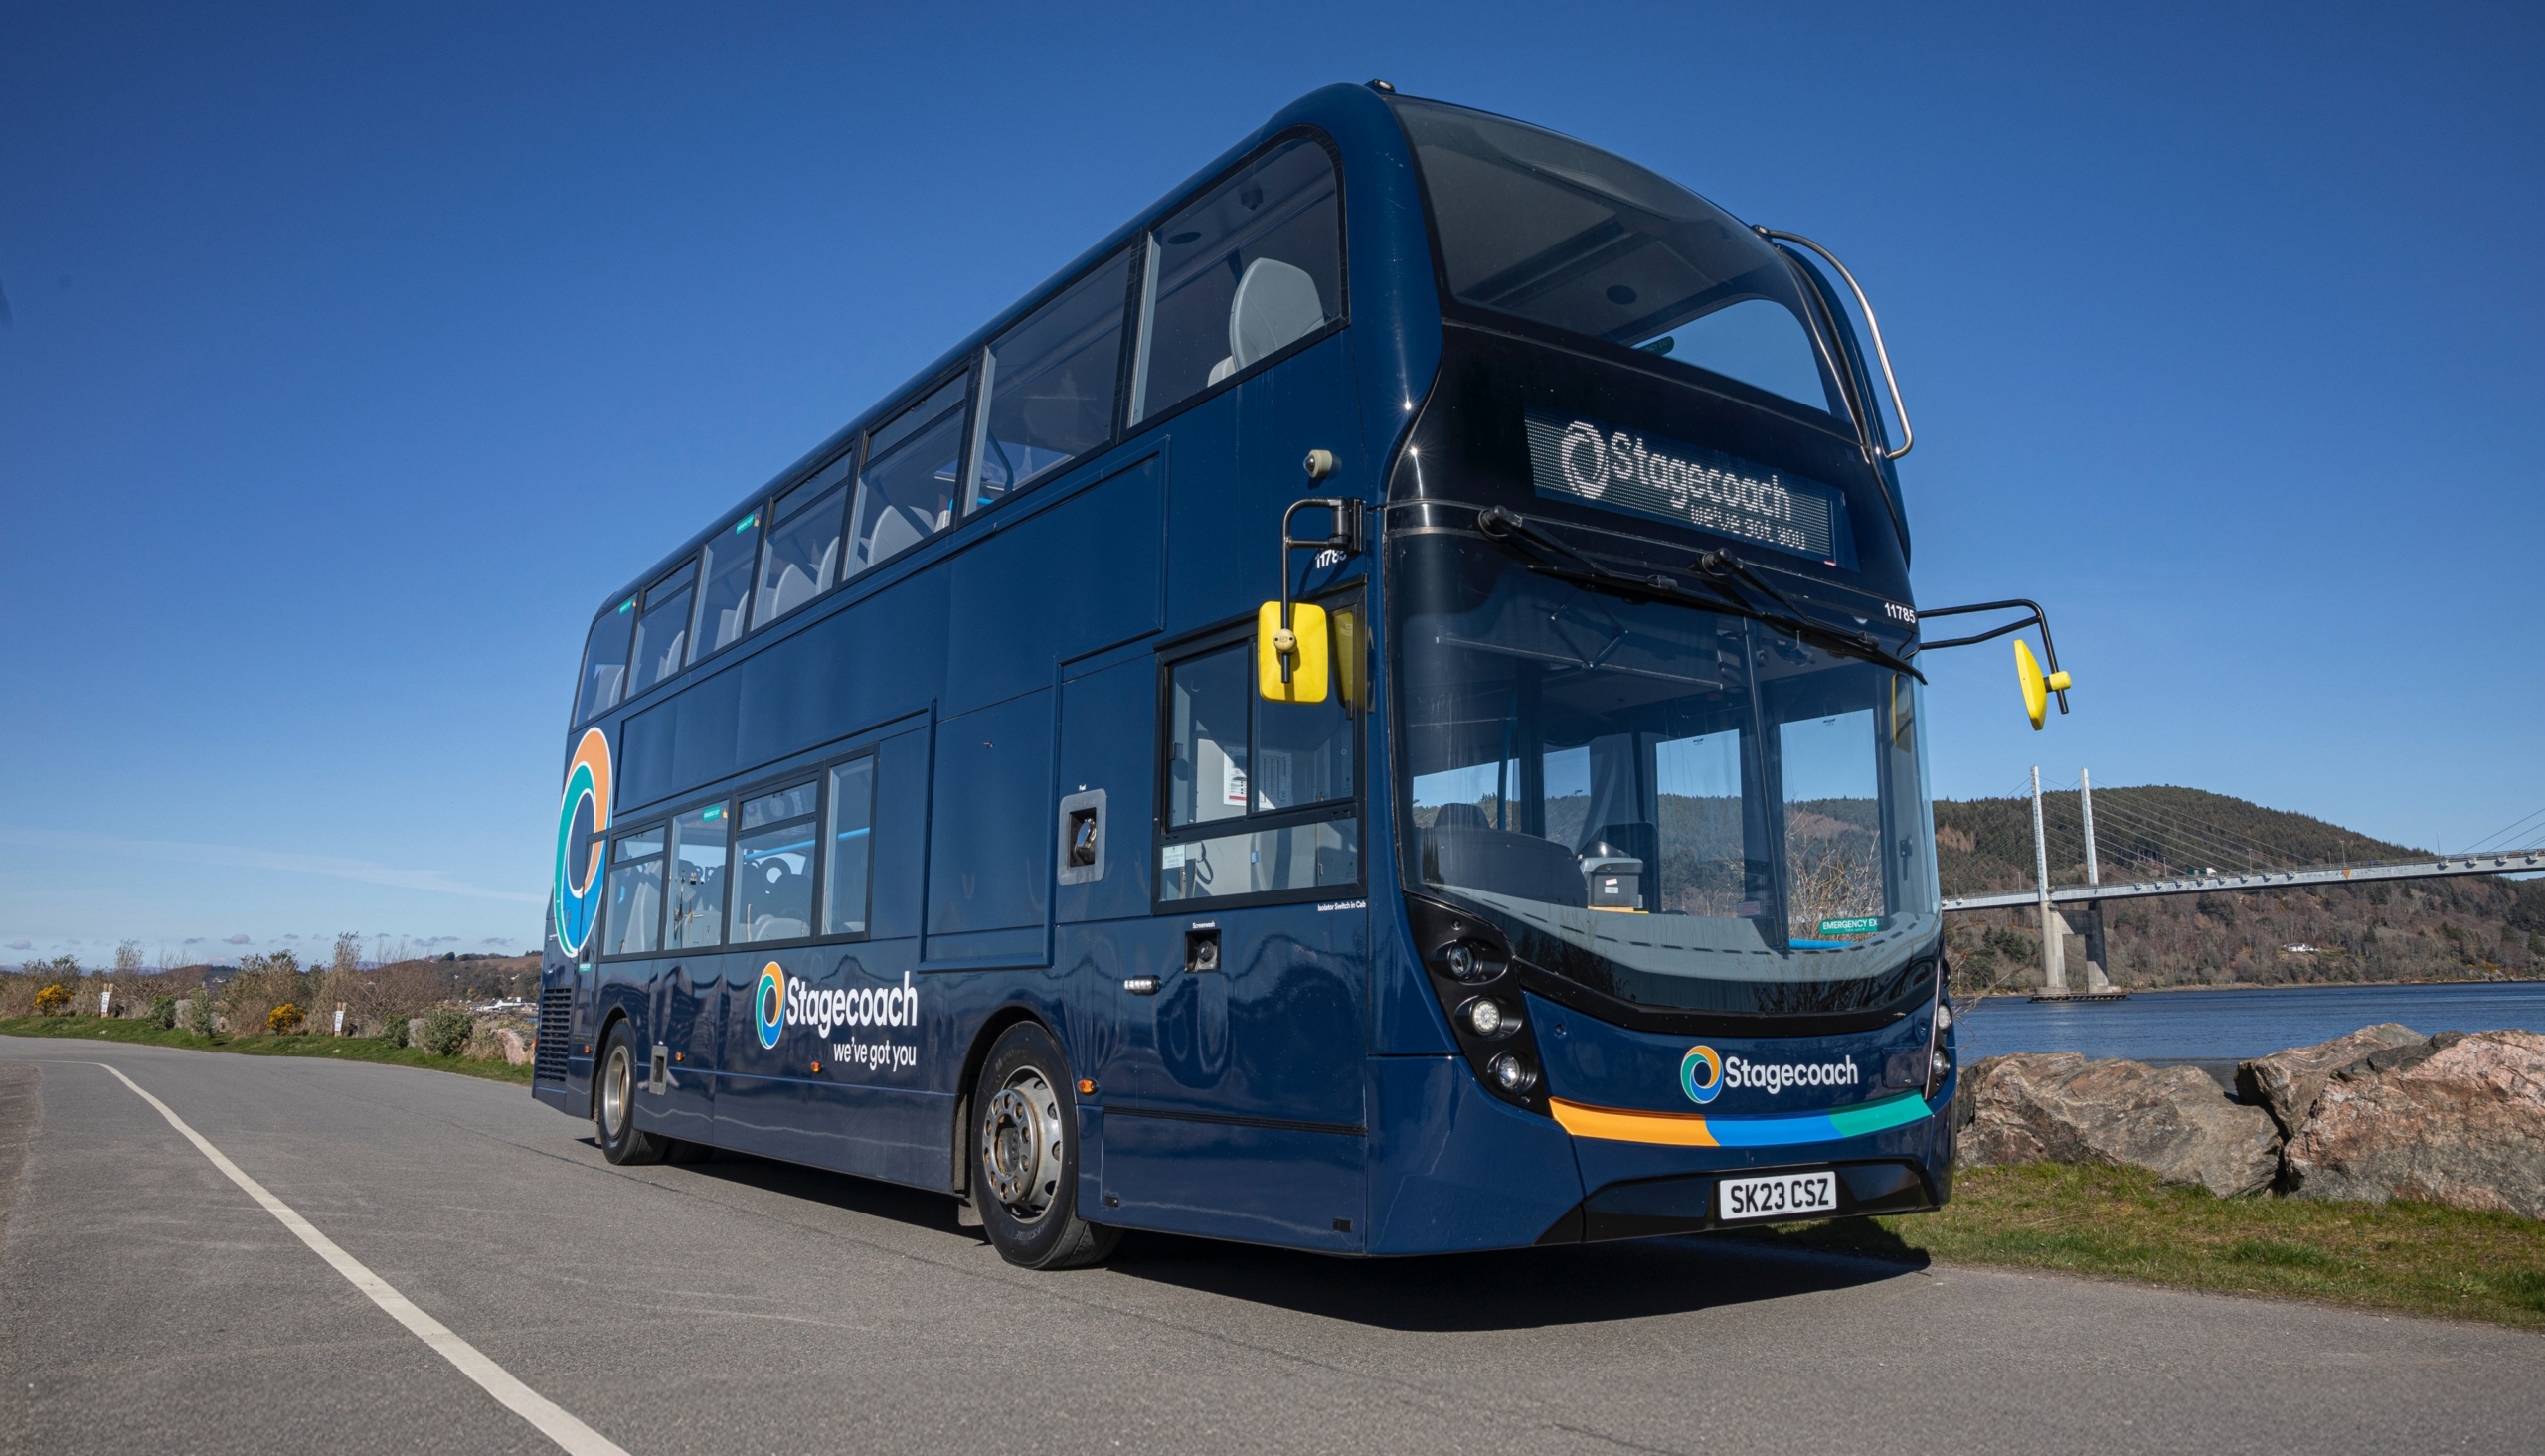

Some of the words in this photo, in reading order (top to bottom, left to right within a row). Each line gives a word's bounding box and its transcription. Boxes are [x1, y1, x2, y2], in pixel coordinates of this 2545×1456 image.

[1611, 432, 1791, 521] Stagecoach
[1690, 505, 1740, 534] we've
[1745, 518, 1774, 542] got
[1777, 526, 1805, 550] you
[1884, 602, 1916, 624] 11785
[1334, 901, 1350, 910] Switch
[1350, 900, 1356, 909] in
[1822, 919, 1868, 930] EMERGENCY
[786, 970, 918, 1039] Stagecoach
[833, 1036, 868, 1064] we've
[869, 1040, 891, 1071] got
[893, 1045, 917, 1072] you
[1725, 1054, 1859, 1095] Stagecoach
[1730, 1181, 1785, 1213] SK23
[1790, 1178, 1829, 1208] CSZ
